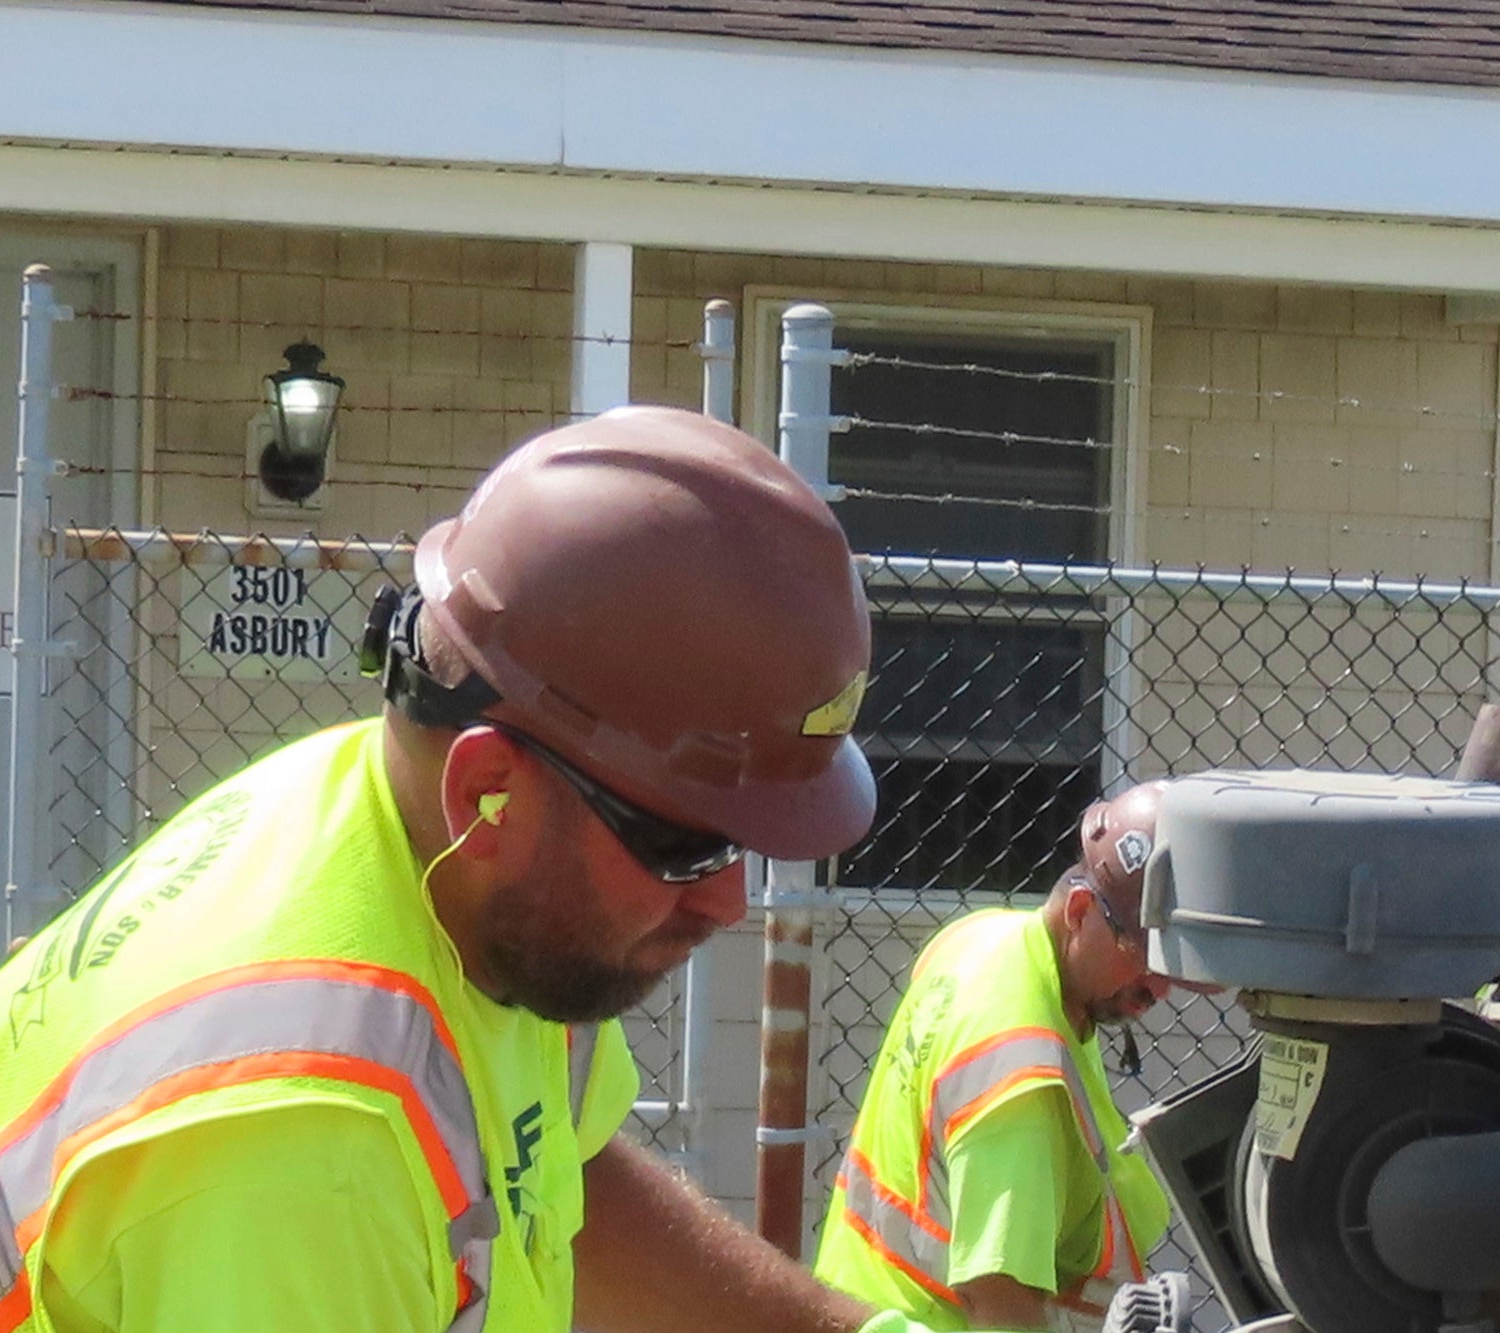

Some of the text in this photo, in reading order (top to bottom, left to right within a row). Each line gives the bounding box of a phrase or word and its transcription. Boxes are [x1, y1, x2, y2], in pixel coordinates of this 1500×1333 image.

[231, 565, 307, 606] 3501
[209, 613, 330, 659] ASBURY
[87, 914, 140, 969] SON
